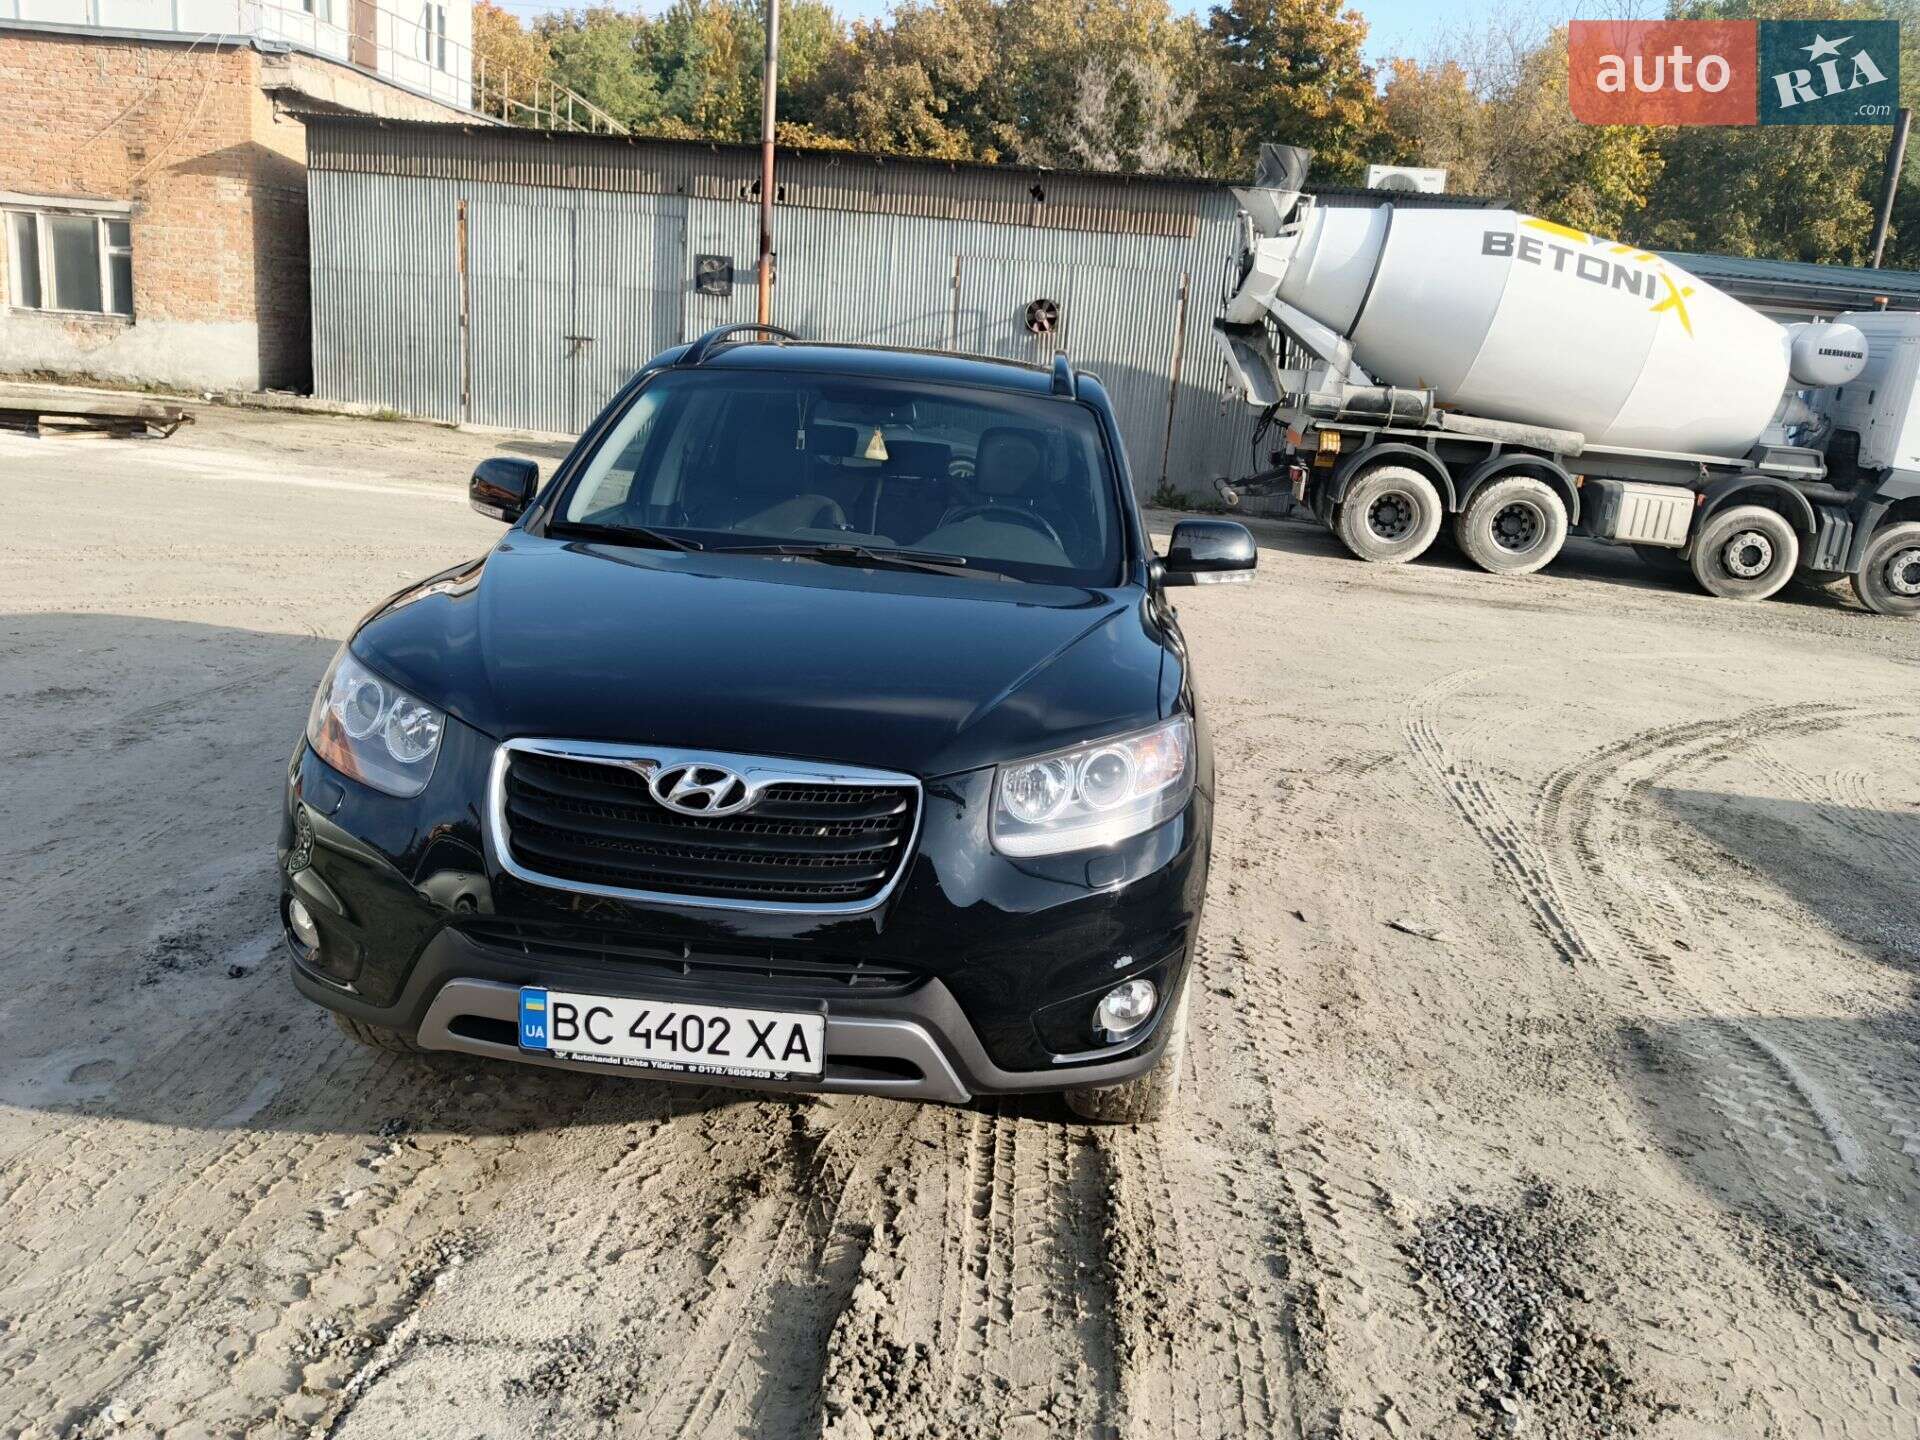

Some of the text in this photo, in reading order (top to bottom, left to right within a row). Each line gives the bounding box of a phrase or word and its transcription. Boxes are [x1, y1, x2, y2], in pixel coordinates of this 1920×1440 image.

[1481, 230, 1695, 339] BETONIX
[1818, 347, 1864, 359] LIEBHERR
[525, 1024, 544, 1038] UA
[552, 1002, 812, 1063] BC 4402 XA
[571, 1052, 621, 1065] Autohandel
